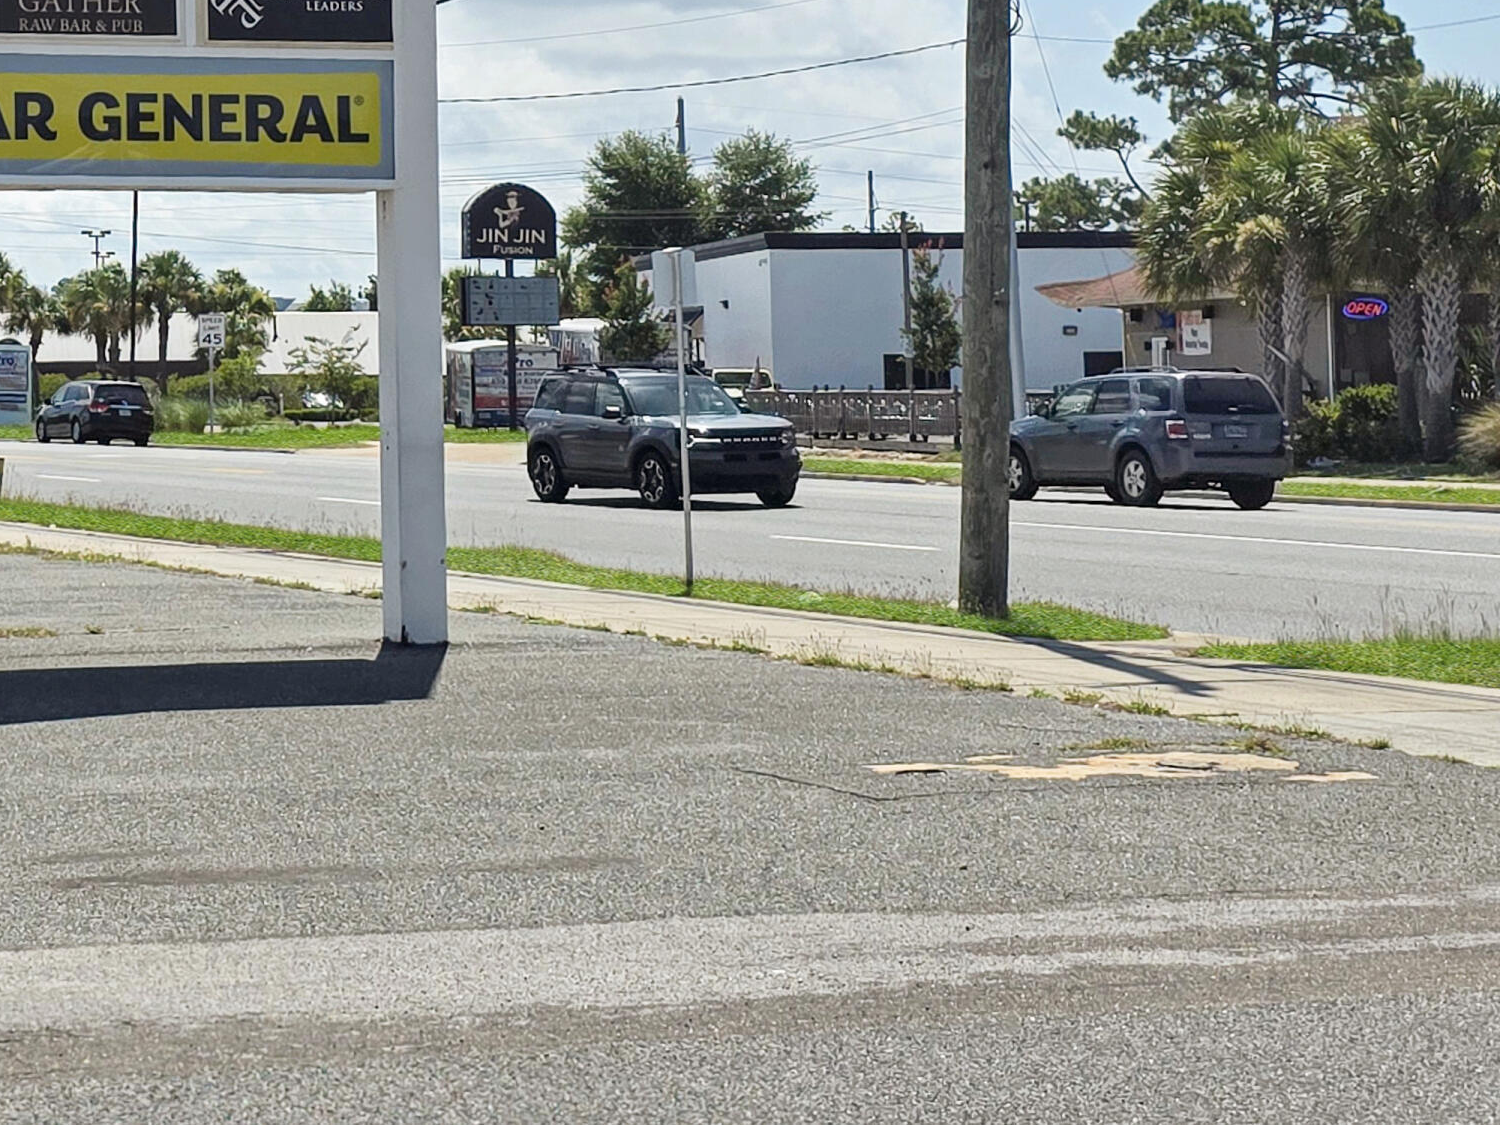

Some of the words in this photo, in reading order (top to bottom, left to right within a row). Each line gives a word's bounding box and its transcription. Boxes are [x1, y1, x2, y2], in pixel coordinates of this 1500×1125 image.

[305, 0, 364, 13] LEADERS
[19, 17, 56, 32] RAW
[60, 18, 92, 32] BAR
[95, 19, 108, 33] &
[112, 19, 143, 33] PUB
[476, 228, 509, 244] JIN
[513, 229, 546, 245] JIN
[1347, 301, 1383, 316] OPEN
[202, 333, 222, 345] 45
